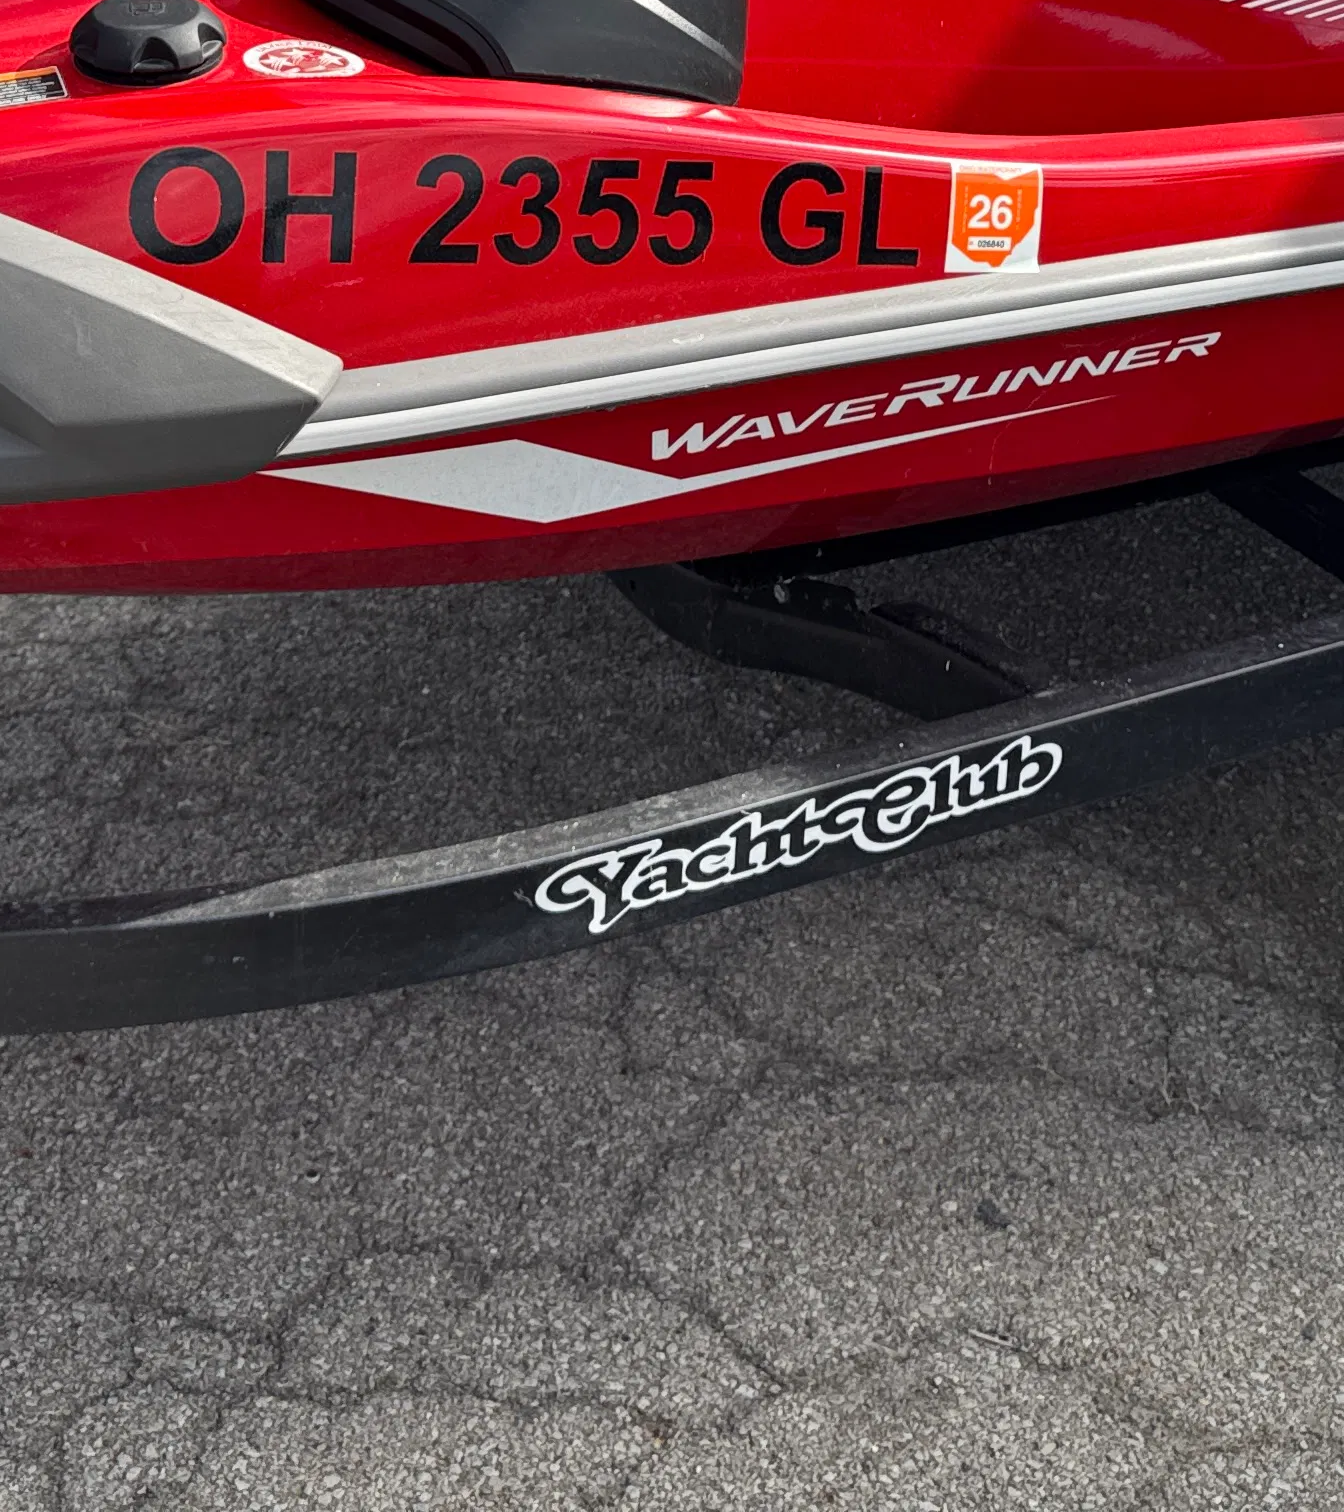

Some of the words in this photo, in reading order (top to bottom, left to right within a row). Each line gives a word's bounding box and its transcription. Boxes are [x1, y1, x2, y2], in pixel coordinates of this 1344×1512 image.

[128, 146, 358, 266] OH
[410, 154, 716, 267] 2355
[759, 161, 920, 268] GL
[967, 193, 1013, 231] 26
